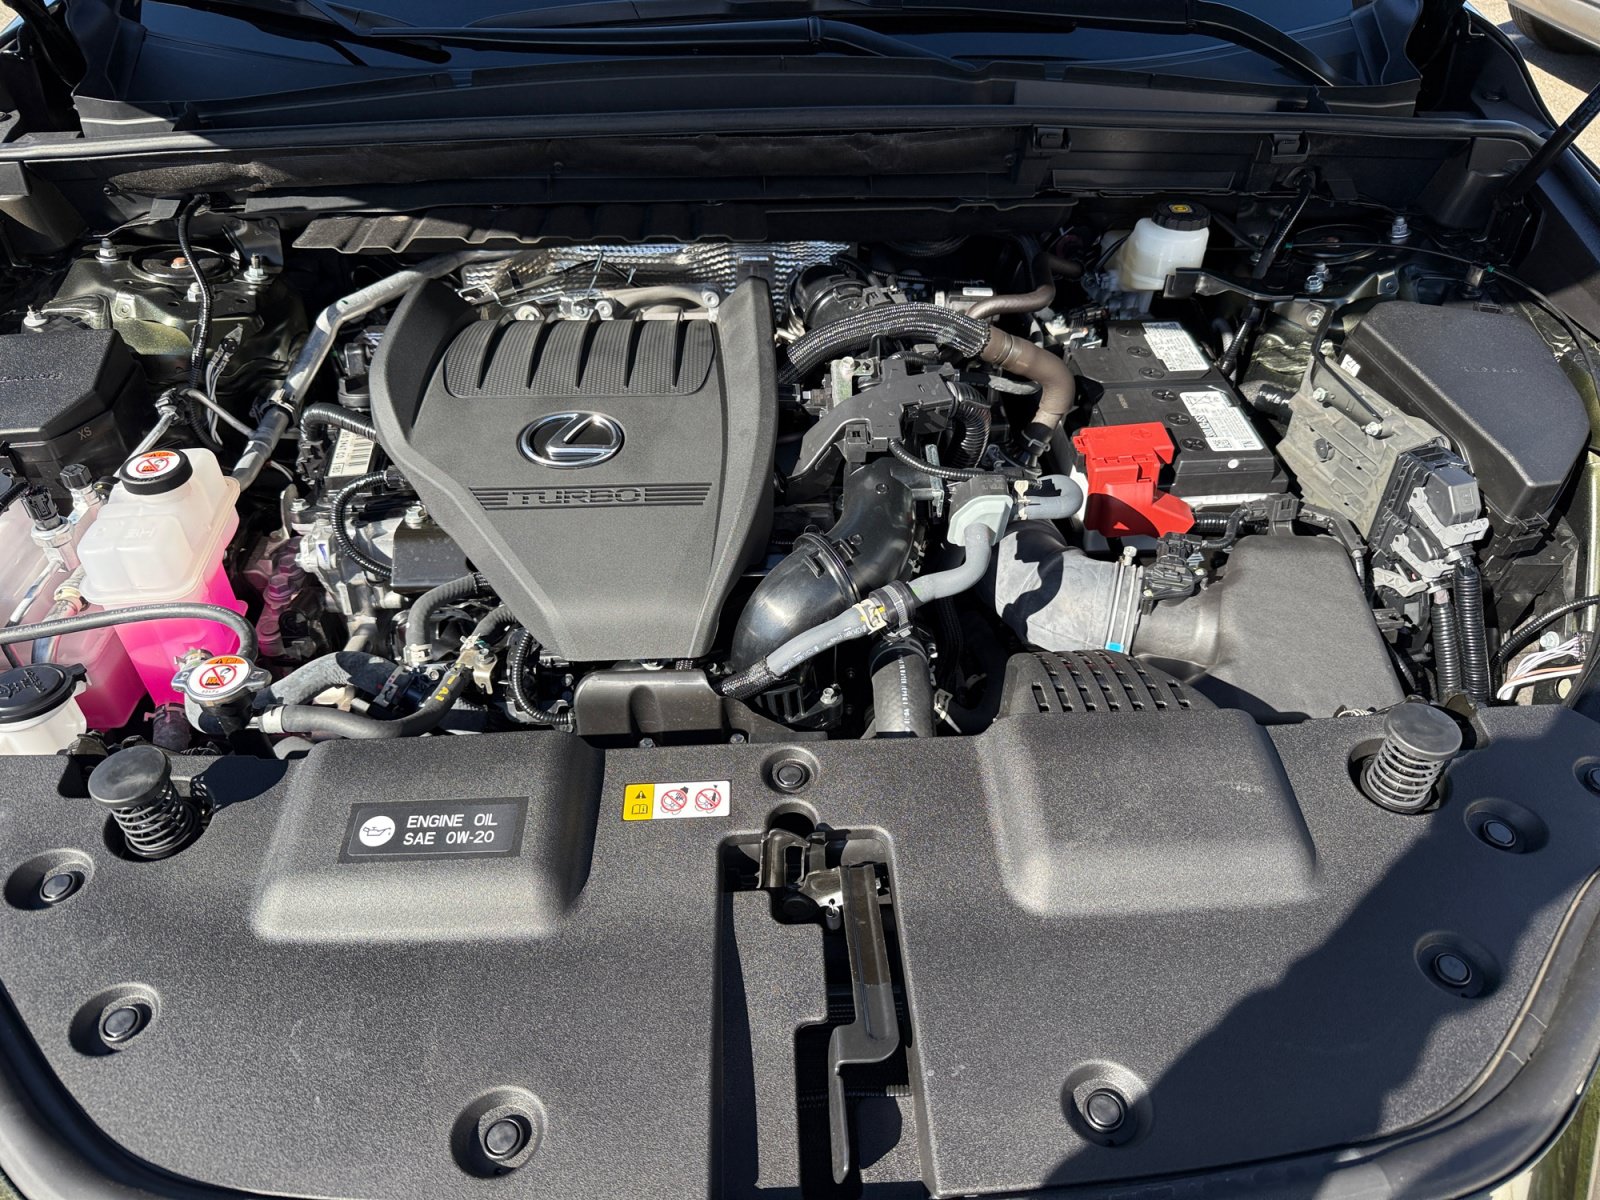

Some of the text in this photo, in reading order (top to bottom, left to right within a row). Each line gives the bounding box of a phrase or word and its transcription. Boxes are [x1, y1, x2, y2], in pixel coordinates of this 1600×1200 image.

[78, 426, 92, 441] XS
[512, 487, 641, 505] TURBO
[407, 813, 499, 829] ENGINE OIL
[403, 830, 495, 846] SAE 0W-20
